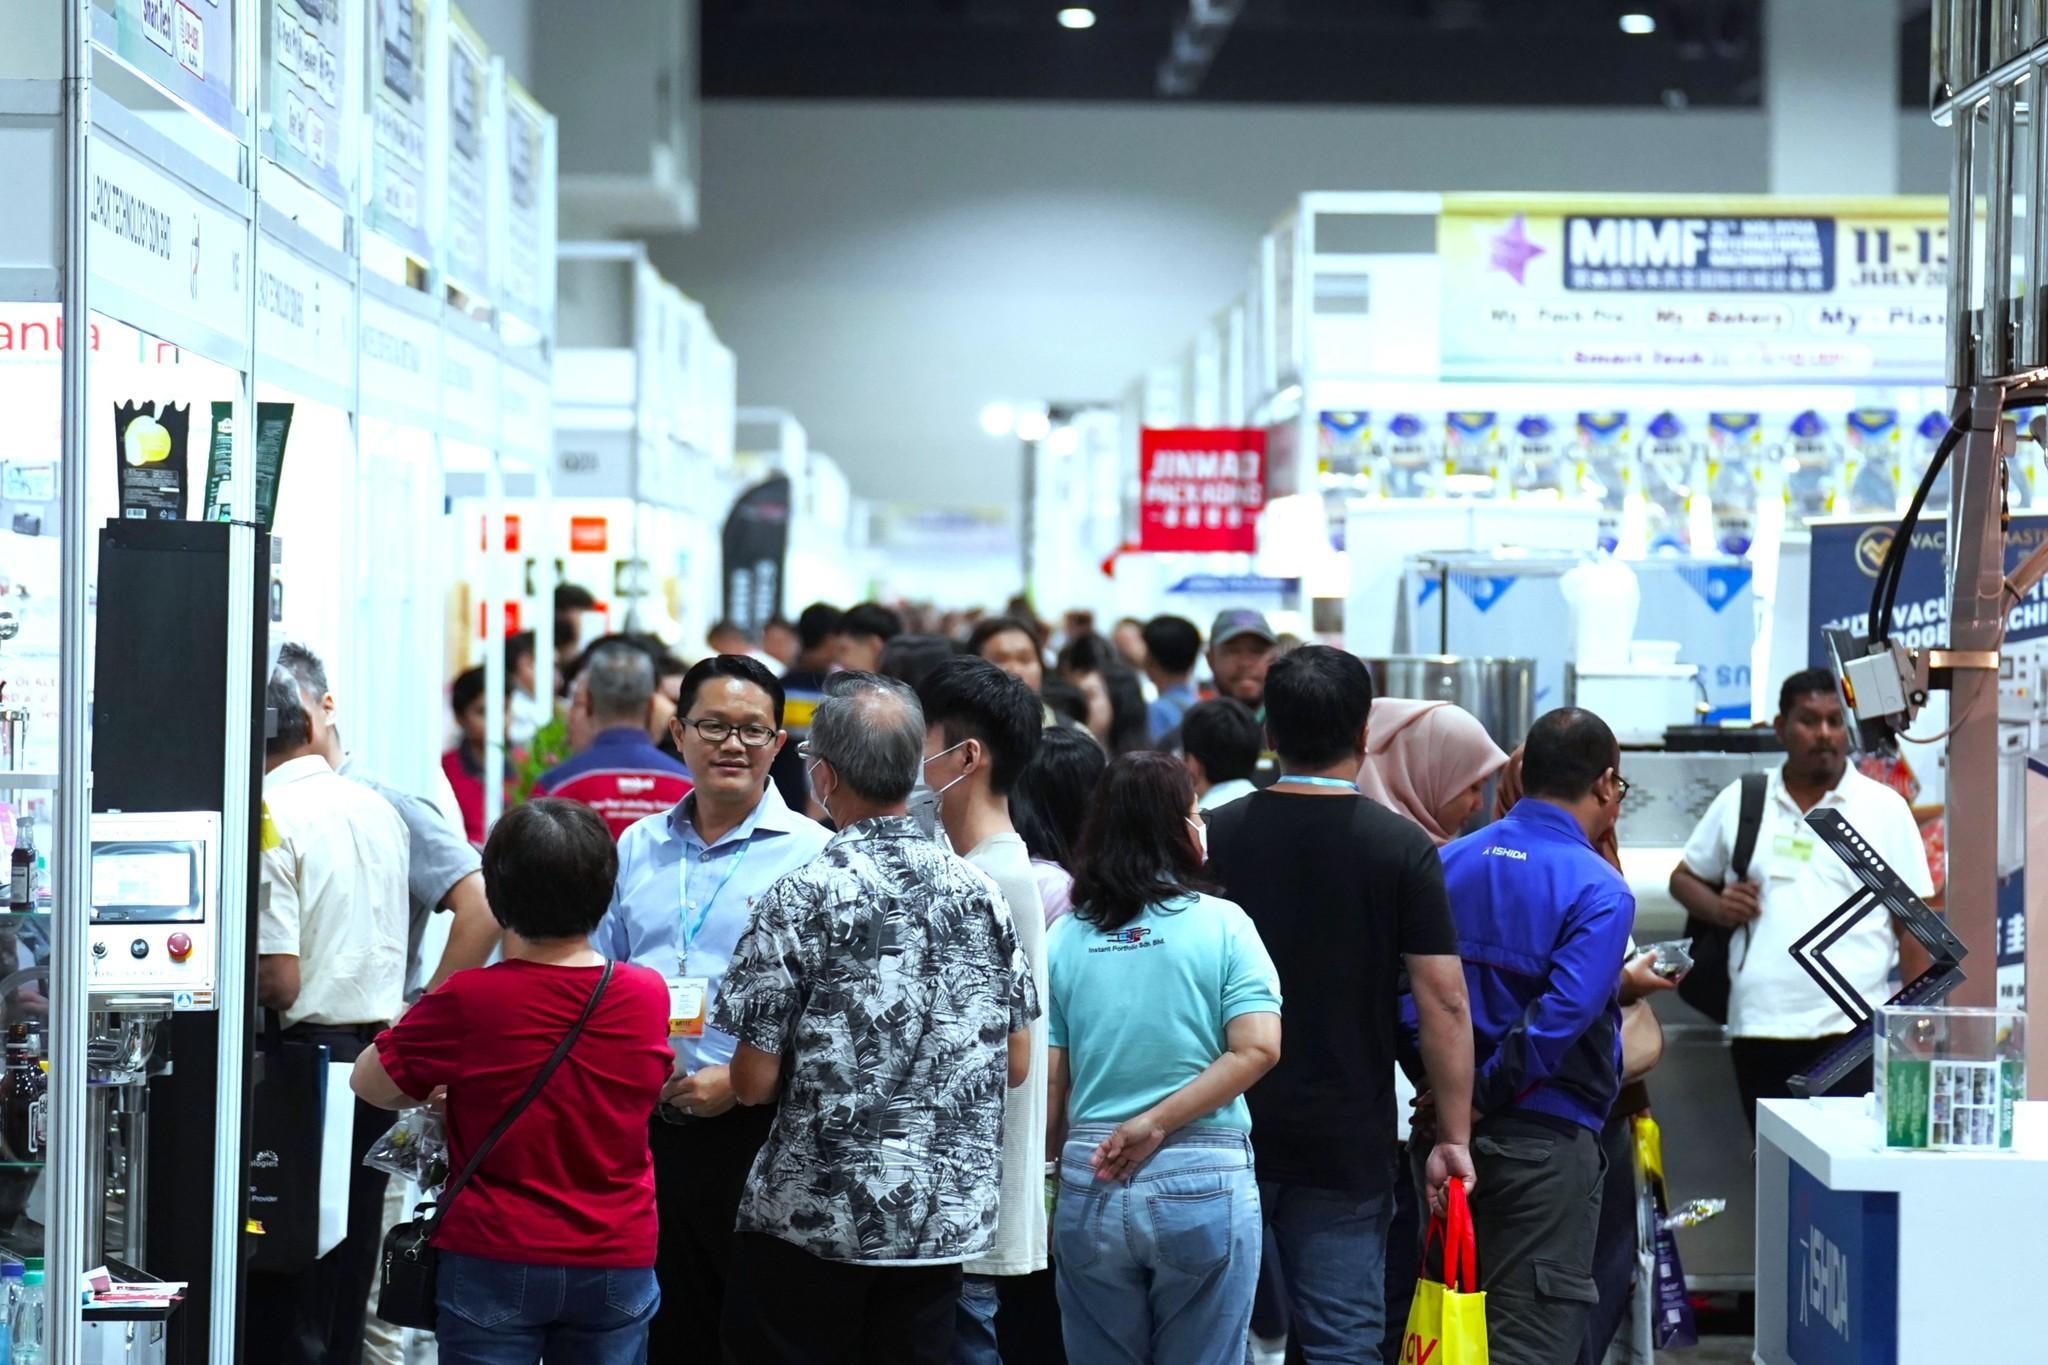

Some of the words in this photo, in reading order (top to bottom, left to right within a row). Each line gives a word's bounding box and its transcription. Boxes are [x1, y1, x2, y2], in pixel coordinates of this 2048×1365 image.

[1570, 217, 1707, 268] MIMF
[1821, 307, 1860, 335] My
[2004, 599, 2048, 633] CHI
[1491, 845, 1528, 861] ISHIDA
[1088, 945, 1111, 953] Instant
